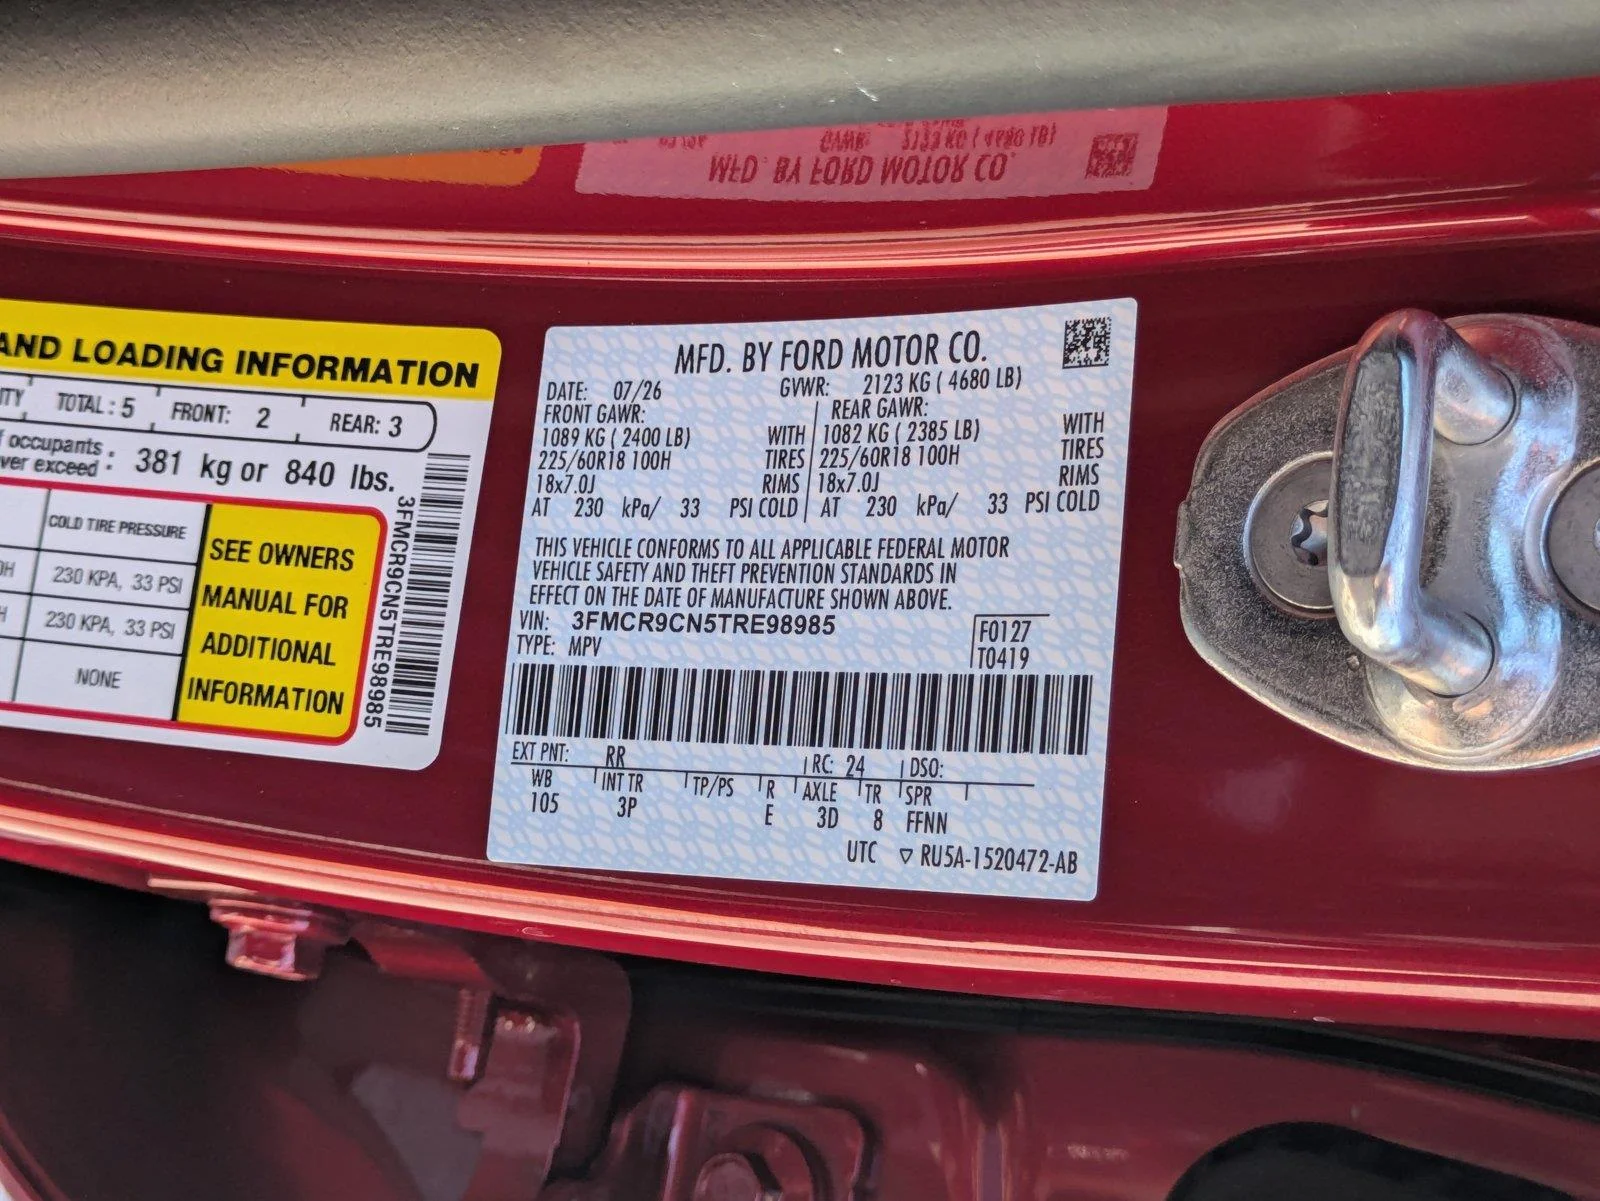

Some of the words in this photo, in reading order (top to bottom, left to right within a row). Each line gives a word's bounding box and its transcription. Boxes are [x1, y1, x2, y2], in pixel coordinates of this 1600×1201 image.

[73, 338, 224, 374] LOADING
[236, 350, 480, 389] INFORMATION
[674, 342, 731, 374] MFD.
[742, 341, 772, 373] BY
[780, 339, 843, 371] FORD
[851, 333, 939, 369] MOTOR
[949, 330, 987, 363] CO.
[546, 381, 588, 401] DATE:
[613, 380, 662, 403] 07/26
[780, 376, 830, 397] GVWR:
[862, 373, 903, 395] 2123
[909, 372, 931, 393] KG
[949, 370, 989, 391] 4680
[996, 366, 1022, 390] LB)
[121, 397, 135, 419] 5
[171, 402, 231, 425] FRONT:
[256, 408, 270, 429] 2
[544, 404, 591, 423] FRONT
[596, 404, 645, 424] GAWR:
[831, 399, 872, 420] REAR
[876, 397, 929, 418] GAWR:
[329, 413, 380, 436] REAR:
[388, 415, 403, 438] 3
[824, 423, 861, 444] 1082
[867, 422, 889, 444] KG
[907, 420, 948, 442] 2385
[954, 418, 981, 442] LB)
[1062, 412, 1105, 435] WITH
[542, 427, 579, 447] 1089
[584, 428, 605, 447] KG
[622, 427, 660, 447] 2400
[665, 427, 691, 450] LB)
[767, 425, 806, 446] WITH
[537, 450, 625, 471] 225/60R18
[632, 450, 672, 470] 100H
[765, 448, 805, 470] TIRES
[818, 445, 911, 470] 225/60R18
[918, 444, 960, 466] 100H
[1061, 438, 1104, 461] TIRES
[34, 458, 99, 477] exceed
[135, 448, 181, 475] 381
[200, 454, 232, 486] kg
[240, 462, 268, 483] or
[284, 460, 335, 488] 840
[351, 464, 396, 493] lbs.
[1058, 464, 1100, 487] RIMS
[536, 474, 596, 494] 18x7.0J
[762, 473, 800, 494] RIMS
[818, 471, 880, 494] 18x7.0J
[531, 498, 552, 517] AT
[574, 498, 603, 517] 230
[621, 496, 662, 520] kPa/
[680, 498, 700, 518] 33
[729, 498, 753, 518] PSI
[758, 498, 798, 518] COLD
[820, 497, 841, 518] AT
[865, 495, 897, 518] 230
[916, 492, 959, 519] kPa/
[987, 492, 1008, 515] 33
[1024, 491, 1051, 514] PSI
[1056, 489, 1101, 513] COLD
[48, 514, 83, 530] COLD
[87, 517, 116, 533] TIRE
[119, 520, 187, 540] PRESSURE
[209, 538, 251, 562] SEE
[258, 542, 355, 571] OWNERS
[535, 536, 568, 557] THIS
[572, 537, 632, 559] VEHICLE
[637, 538, 720, 560] CONFORMS
[725, 538, 745, 560] TO
[749, 538, 776, 560] ALL
[781, 538, 872, 560] APPLICABLE
[877, 537, 945, 559] FEDERAL
[950, 535, 1010, 559] MOTOR
[53, 565, 84, 585] 230
[88, 570, 122, 592] KPA,
[133, 573, 156, 592] 33
[158, 575, 182, 594] PSI
[532, 559, 591, 581] VEHICLE
[596, 560, 649, 583] SAFETY
[652, 562, 686, 584] AND
[691, 562, 736, 584] THEFT
[741, 562, 835, 584] PREVENTION
[840, 562, 934, 584] STANDARDS
[940, 562, 957, 584] IN
[201, 584, 297, 615] MANUAL
[303, 594, 348, 619] FOR
[529, 584, 579, 606] EFFECT
[584, 586, 606, 606] ON
[612, 586, 639, 607] THE
[643, 586, 683, 608] DATE
[687, 587, 707, 608] OF
[710, 587, 825, 609] MANUFACTURE
[830, 588, 890, 610] SHOWN
[894, 588, 952, 610] ABOVE.
[363, 496, 416, 729] 3FMCR9CN5TRE98985
[519, 610, 550, 630] VIN:
[571, 611, 836, 635] 3FMCR9CN5TRE98985
[45, 611, 76, 630] 230
[80, 614, 113, 636] KPA,
[124, 618, 147, 638] 33
[150, 620, 175, 640] PSI
[979, 619, 1032, 643] F0127
[201, 631, 336, 666] ADDITIONAL
[517, 634, 556, 656] TYPE:
[568, 635, 602, 657] MPV
[977, 646, 1030, 670] T0419
[76, 667, 122, 690] NONE
[187, 677, 345, 715] INFORMATION
[512, 741, 536, 760] EXT
[540, 743, 569, 763] PNT:
[606, 745, 625, 768] RR
[812, 753, 833, 774] RC:
[845, 755, 865, 777] 24
[532, 768, 553, 788] WB
[910, 757, 944, 779] DSO:
[601, 771, 625, 792] INT
[627, 772, 644, 793] TR
[693, 775, 734, 798] TP/PS
[766, 779, 774, 799] R
[802, 781, 838, 802] AXLE
[531, 791, 560, 814] 105
[865, 783, 881, 805] TR
[905, 785, 932, 806] SPR
[617, 796, 638, 818] 3P
[765, 803, 774, 826] E
[816, 806, 839, 829] 3D
[873, 808, 883, 831] 8
[906, 810, 948, 835] FFNN
[847, 840, 877, 863] UTC
[920, 843, 1078, 874] RU5A-1520472-AB
